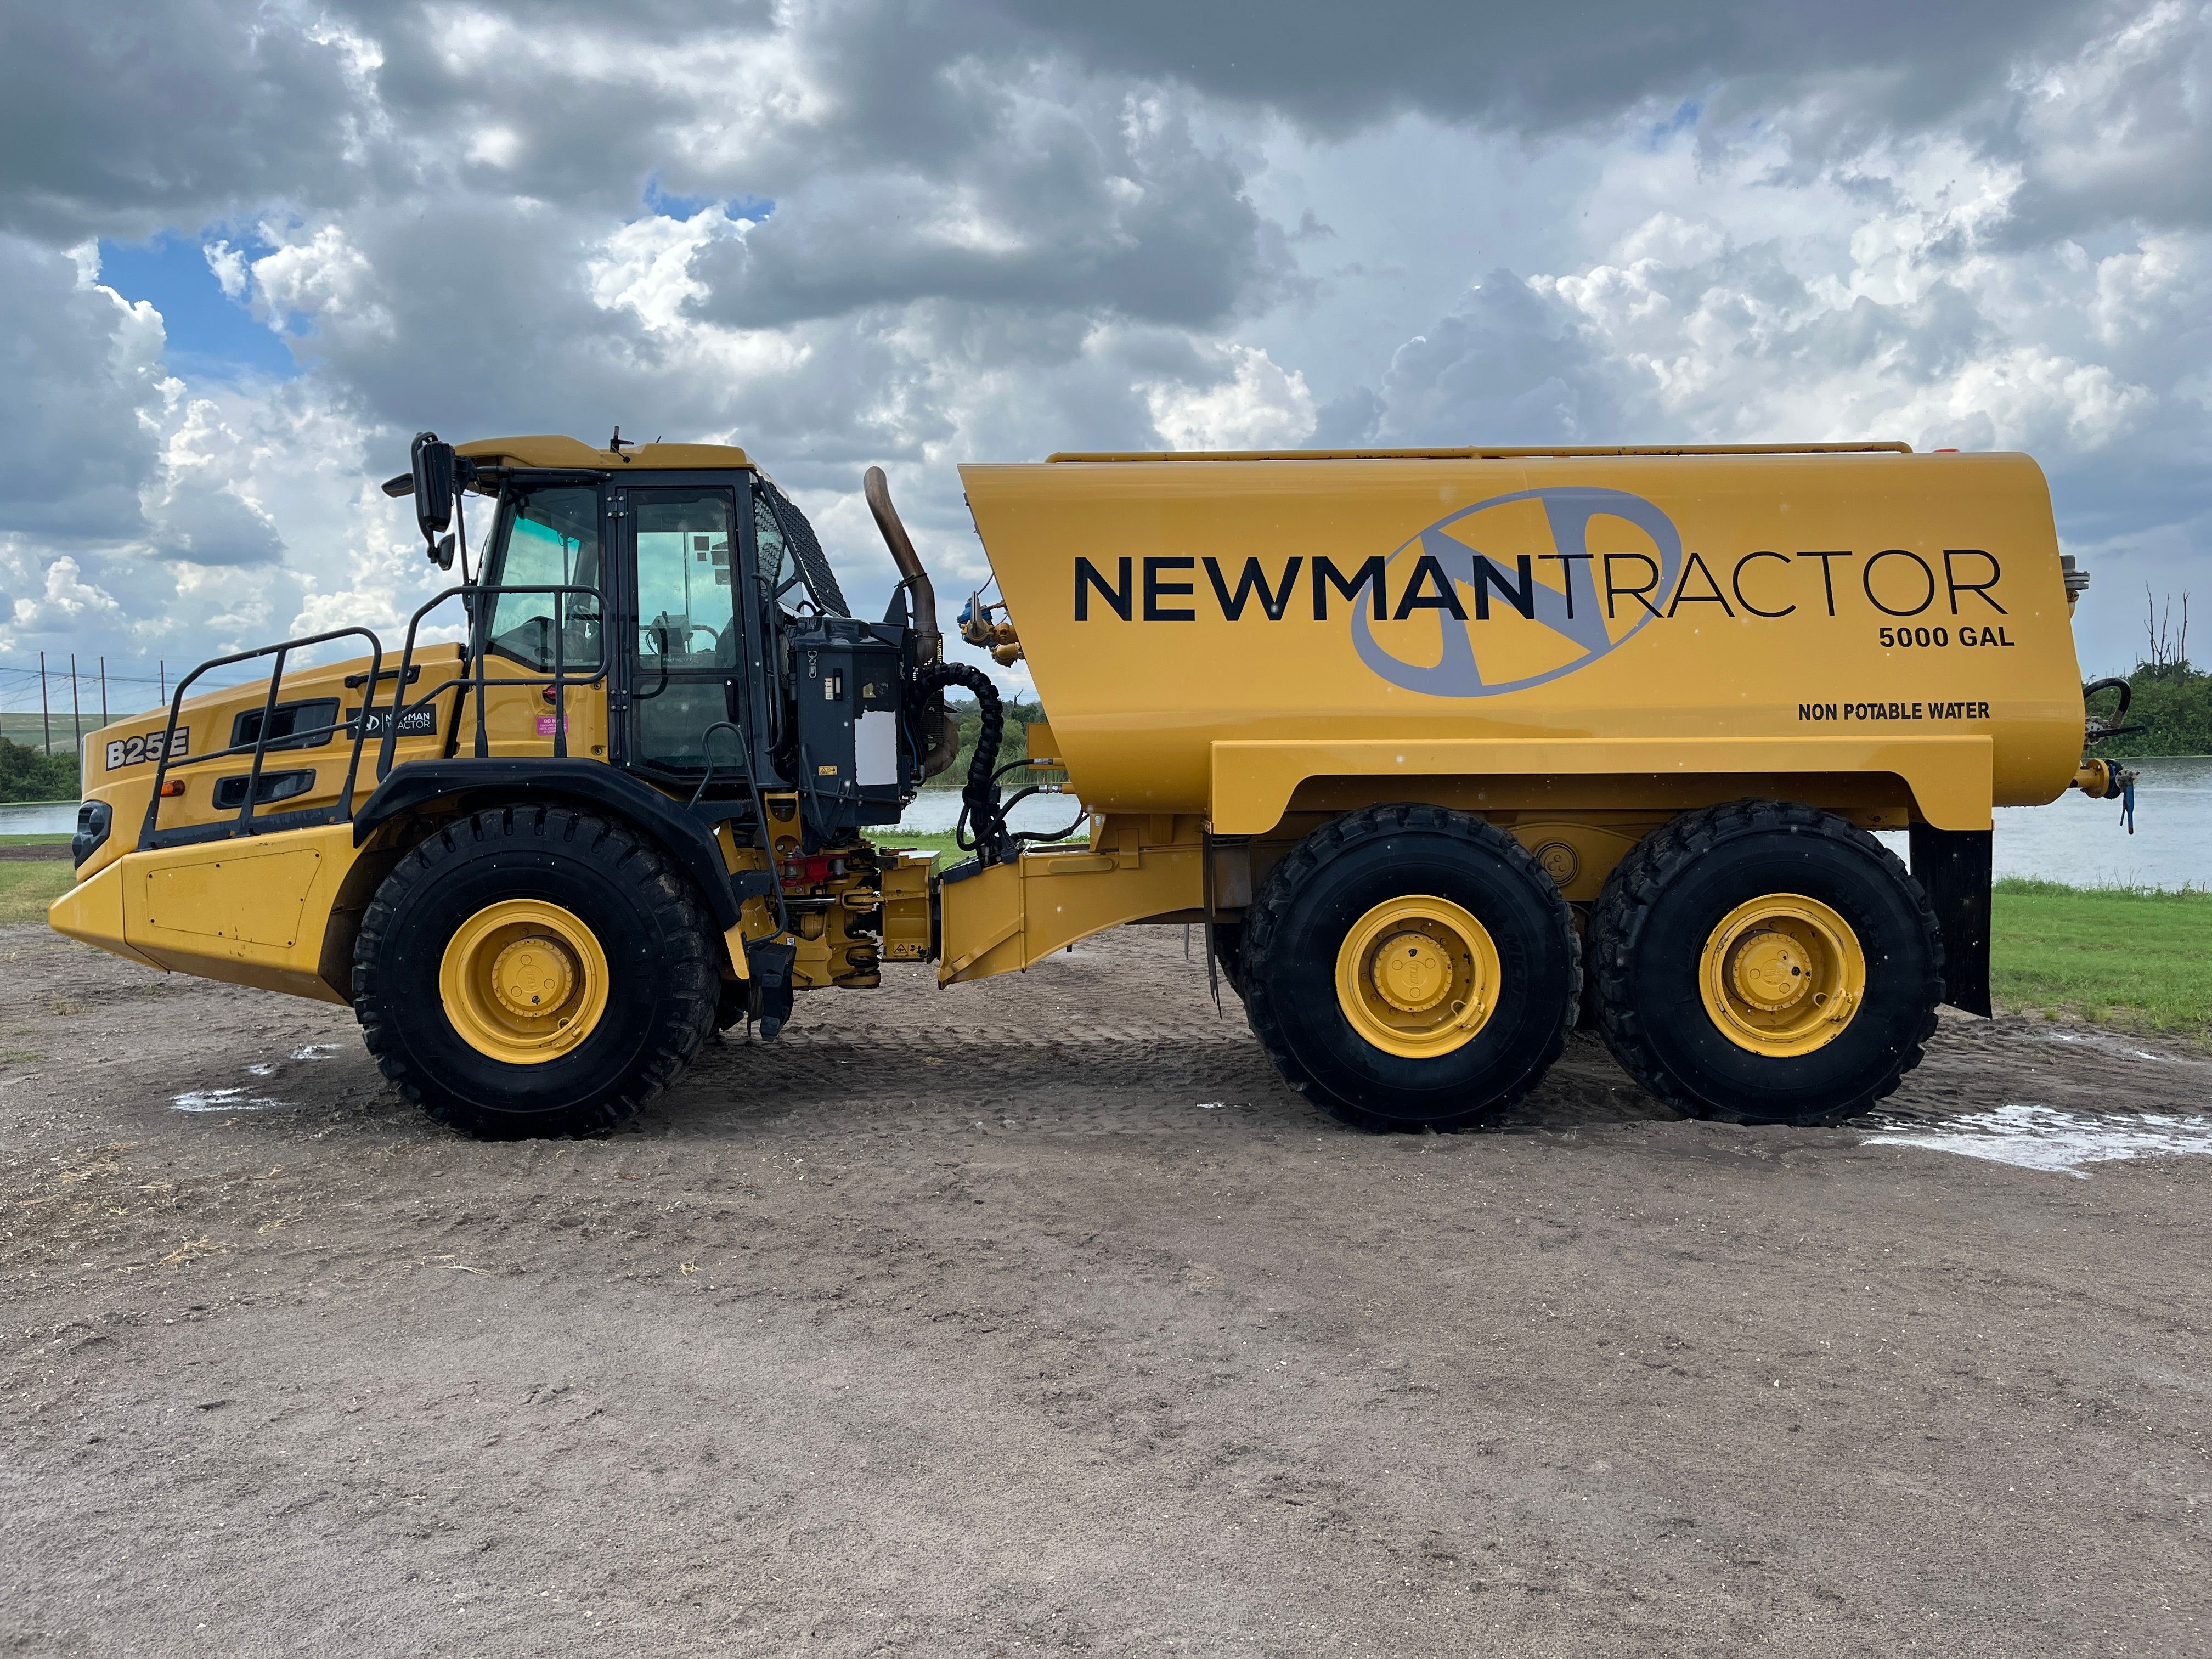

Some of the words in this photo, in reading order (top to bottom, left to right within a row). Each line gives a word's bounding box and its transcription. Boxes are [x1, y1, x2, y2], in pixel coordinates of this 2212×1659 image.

[1880, 627, 1949, 647] 5000
[1959, 626, 2015, 647] GAL
[385, 712, 430, 723] NMAN
[1798, 703, 1837, 720] NON
[1844, 702, 1922, 720] POTABLE
[1927, 702, 1990, 719] WATER
[385, 720, 430, 729] TACTOR
[106, 726, 189, 771] B25E
